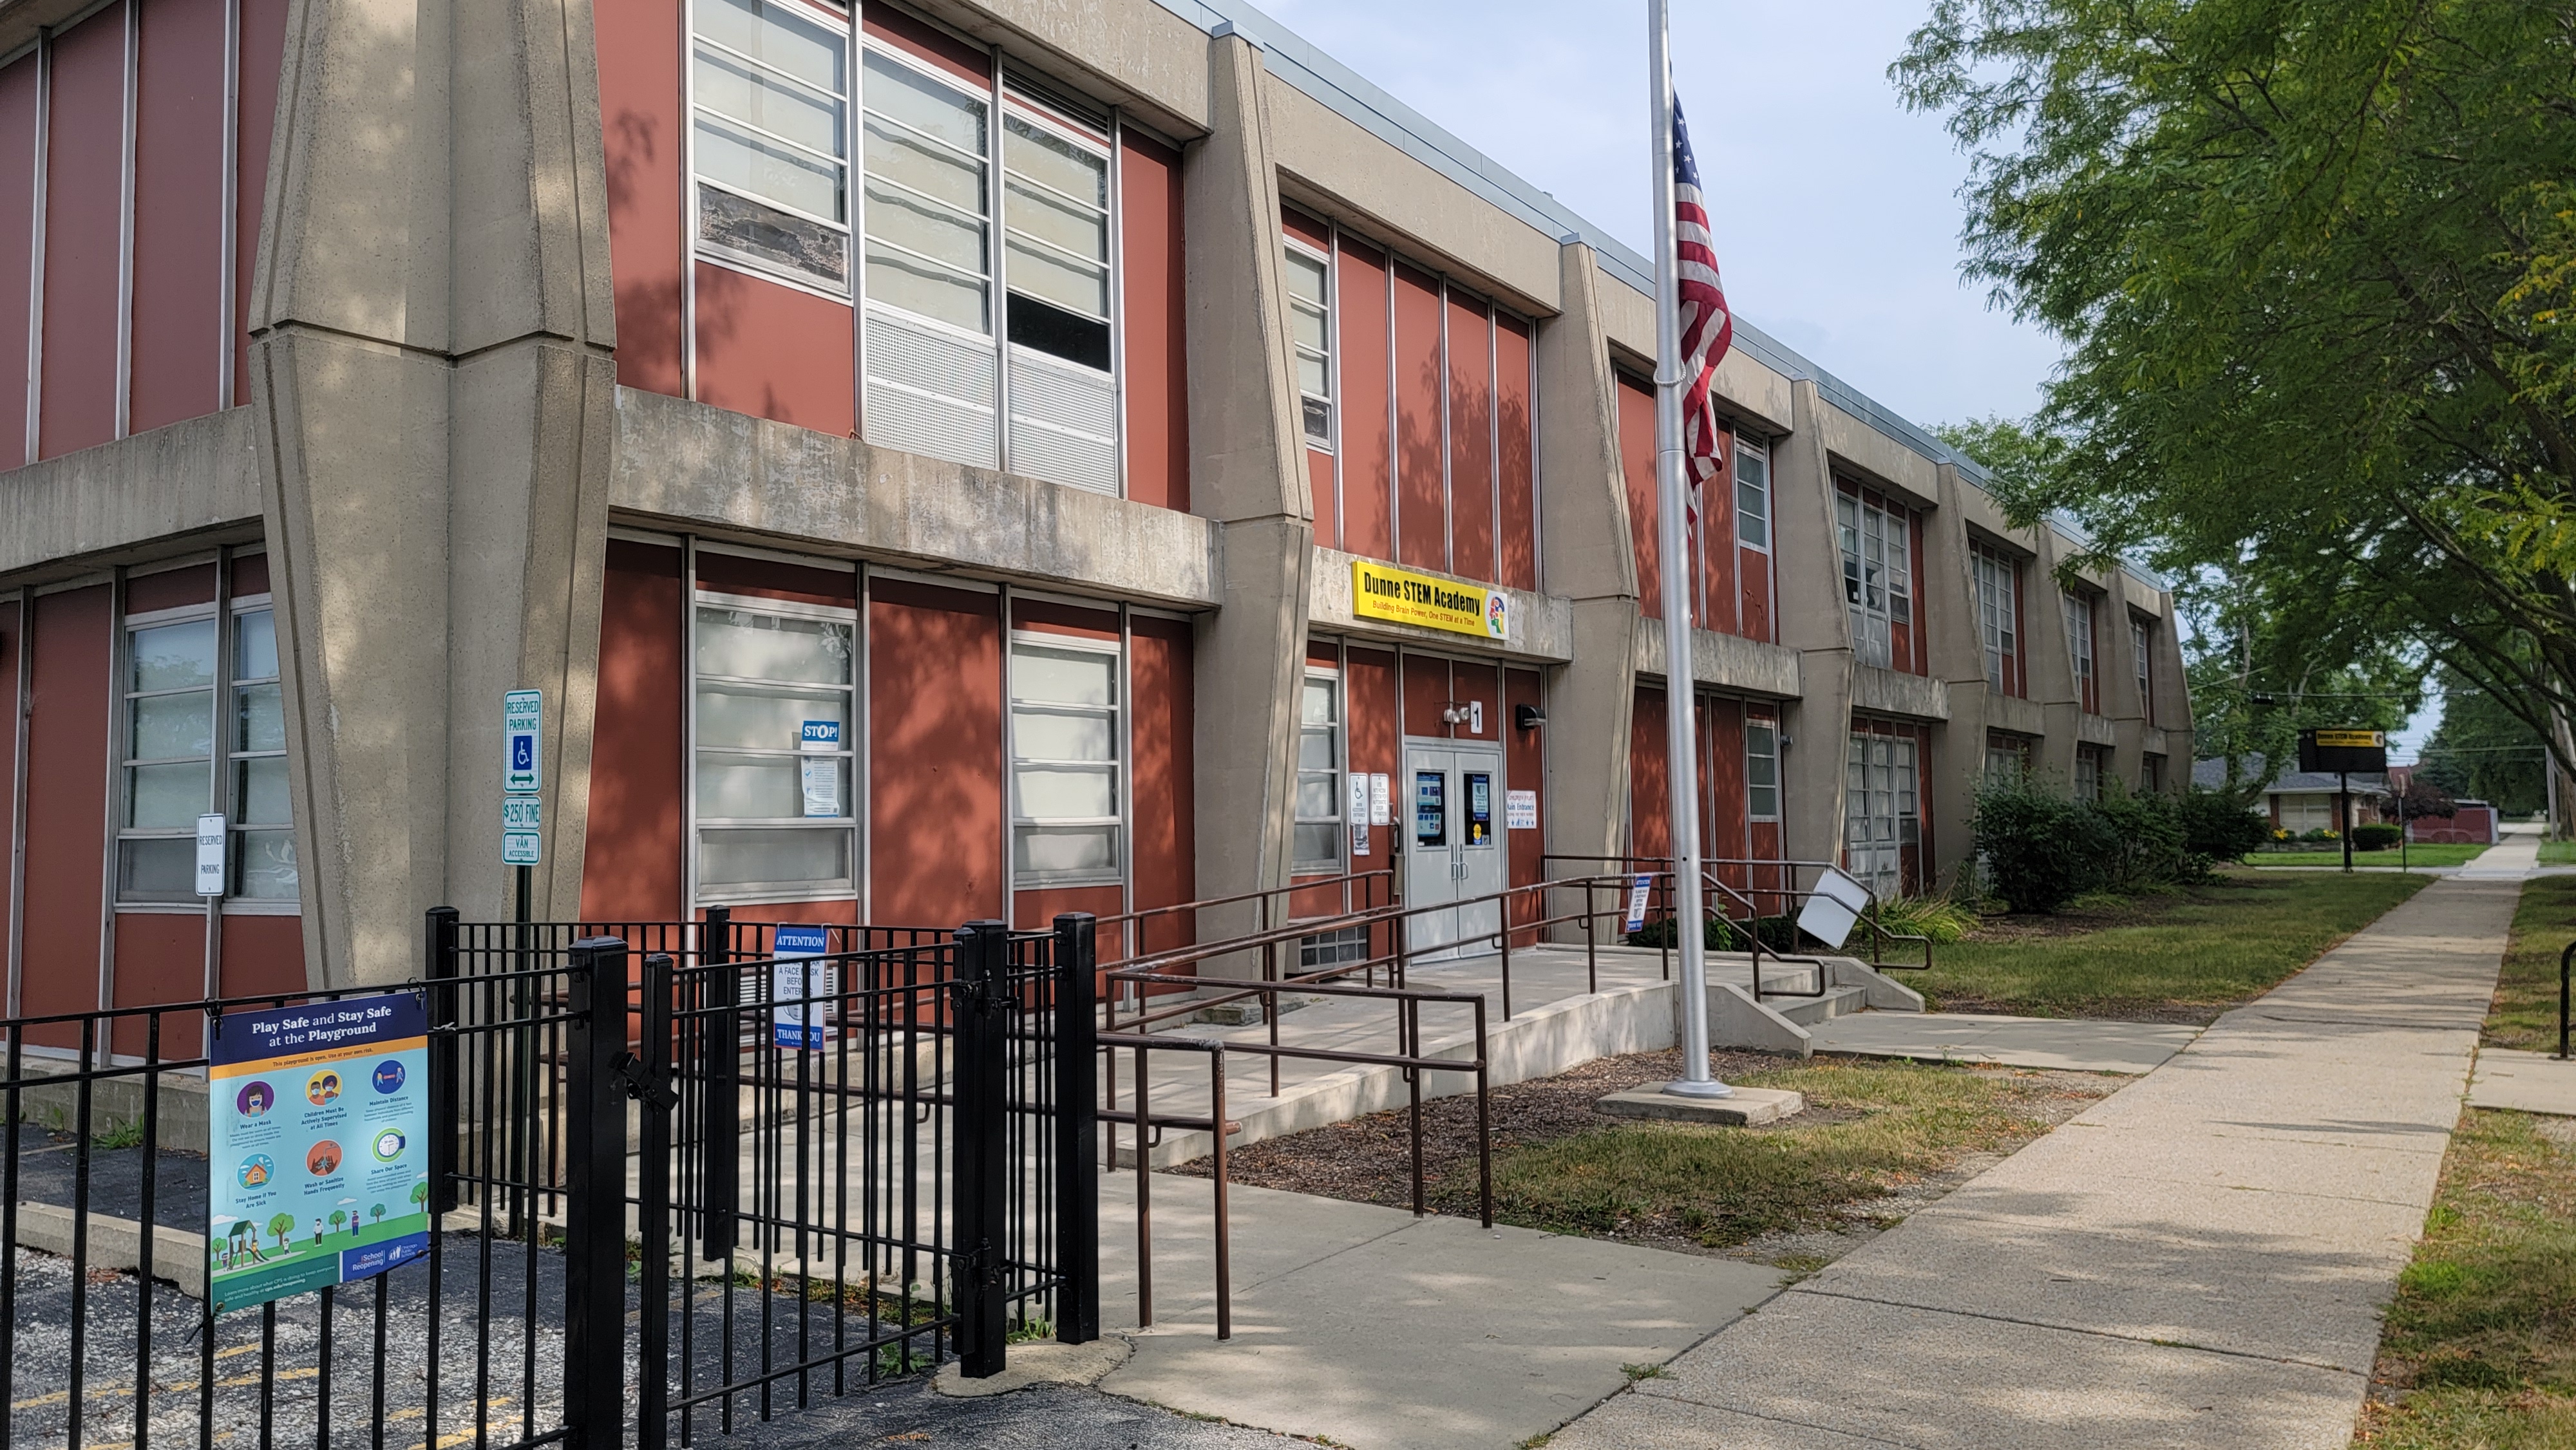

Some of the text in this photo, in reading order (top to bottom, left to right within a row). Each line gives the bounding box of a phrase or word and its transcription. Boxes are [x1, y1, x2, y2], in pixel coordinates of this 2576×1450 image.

[1364, 572, 1480, 616] Dunne STEM Academy
[1372, 600, 1395, 614] Building
[1396, 605, 1410, 614] Brain
[1411, 607, 1428, 619] Power,
[1428, 611, 1439, 619] One
[1439, 613, 1454, 623] STEM
[1463, 617, 1475, 626] Time
[507, 701, 539, 714] RESERVED
[1474, 707, 1479, 728] 1
[509, 718, 536, 731] PARKING
[804, 724, 838, 739] STOP!
[504, 804, 539, 822] $250 FINE
[200, 835, 222, 845] RESERVED
[516, 838, 528, 848] VAN
[201, 864, 220, 874] PARKING
[777, 936, 824, 947] ATTENTION
[784, 967, 799, 975] FACE
[786, 977, 804, 985] BEFO
[783, 986, 813, 995] ENTERG
[252, 1006, 392, 1034] Play Safe and Stay Safe
[269, 1022, 377, 1047] at the Playground
[777, 1029, 802, 1040] THANK
[283, 1057, 309, 1066] playground
[321, 1113, 347, 1122] Supervised
[304, 1183, 345, 1196] Hands Frequently
[363, 1250, 383, 1261] School
[353, 1259, 383, 1271] Reopening
